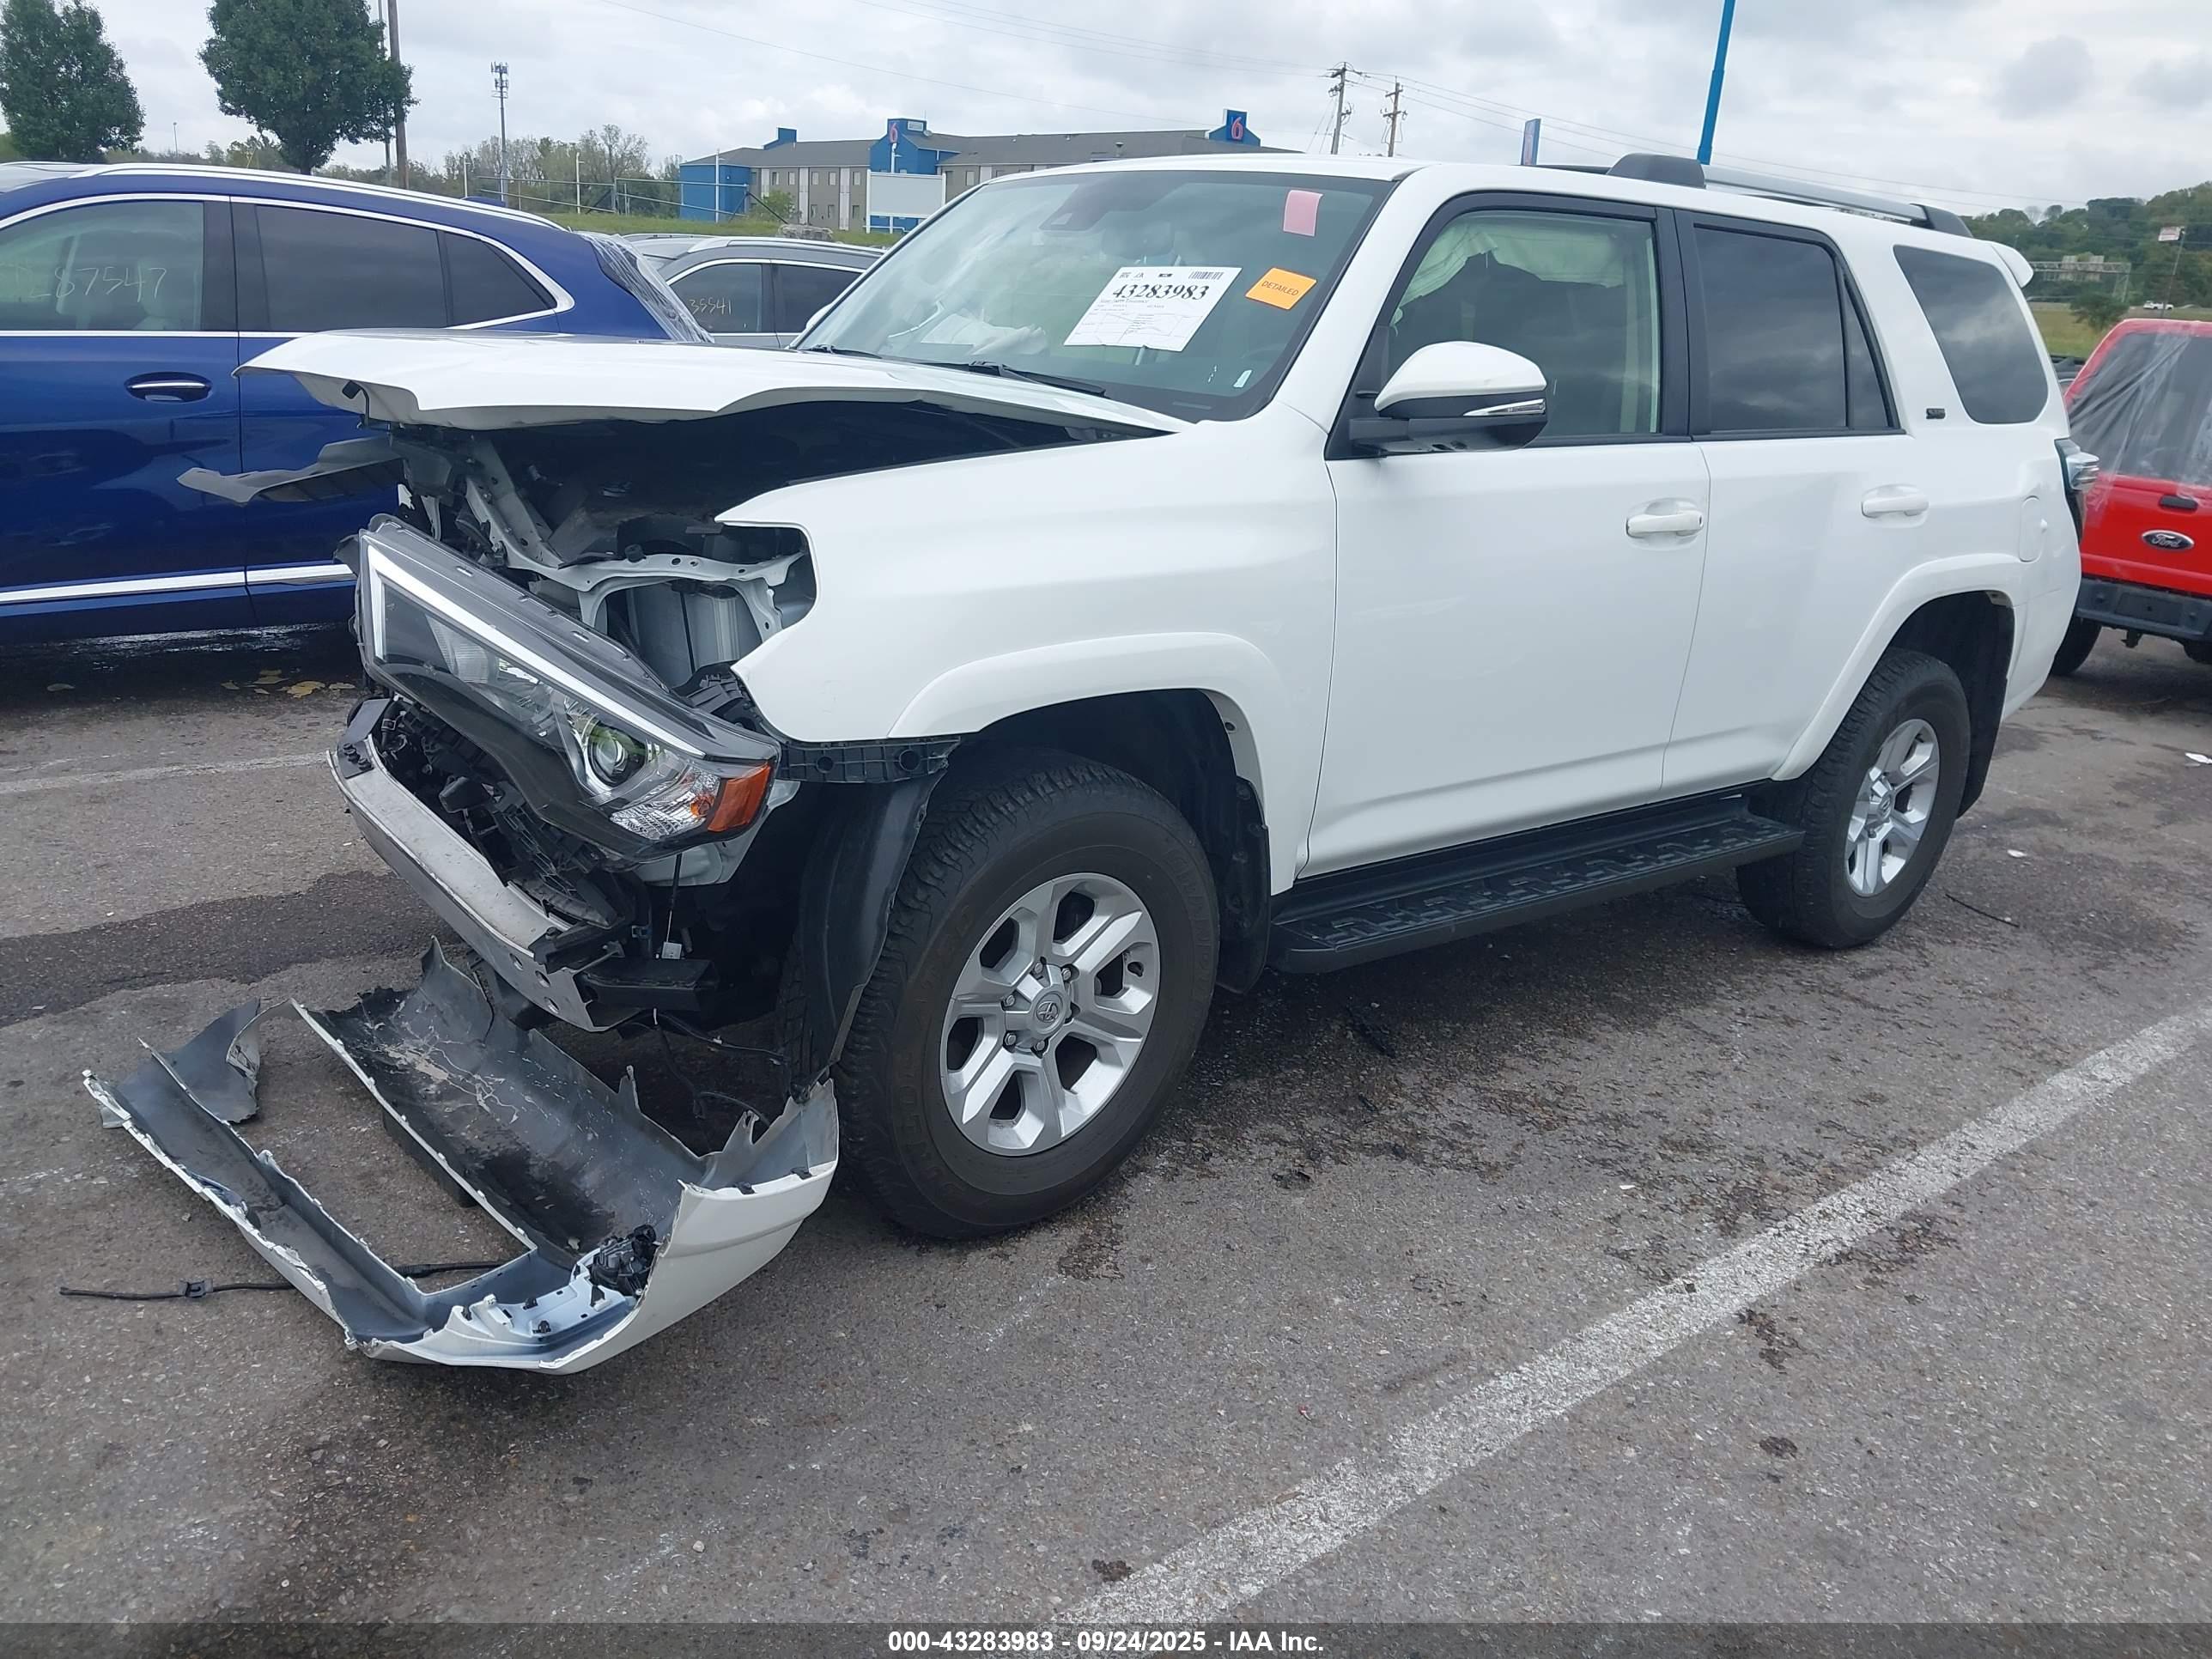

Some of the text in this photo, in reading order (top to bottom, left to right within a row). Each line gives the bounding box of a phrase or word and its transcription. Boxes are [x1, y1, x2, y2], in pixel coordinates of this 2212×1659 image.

[1231, 116, 1243, 140] 6
[1113, 283, 1210, 301] 43283983
[1261, 280, 1299, 296] DETAILED
[2151, 533, 2182, 548] Ford
